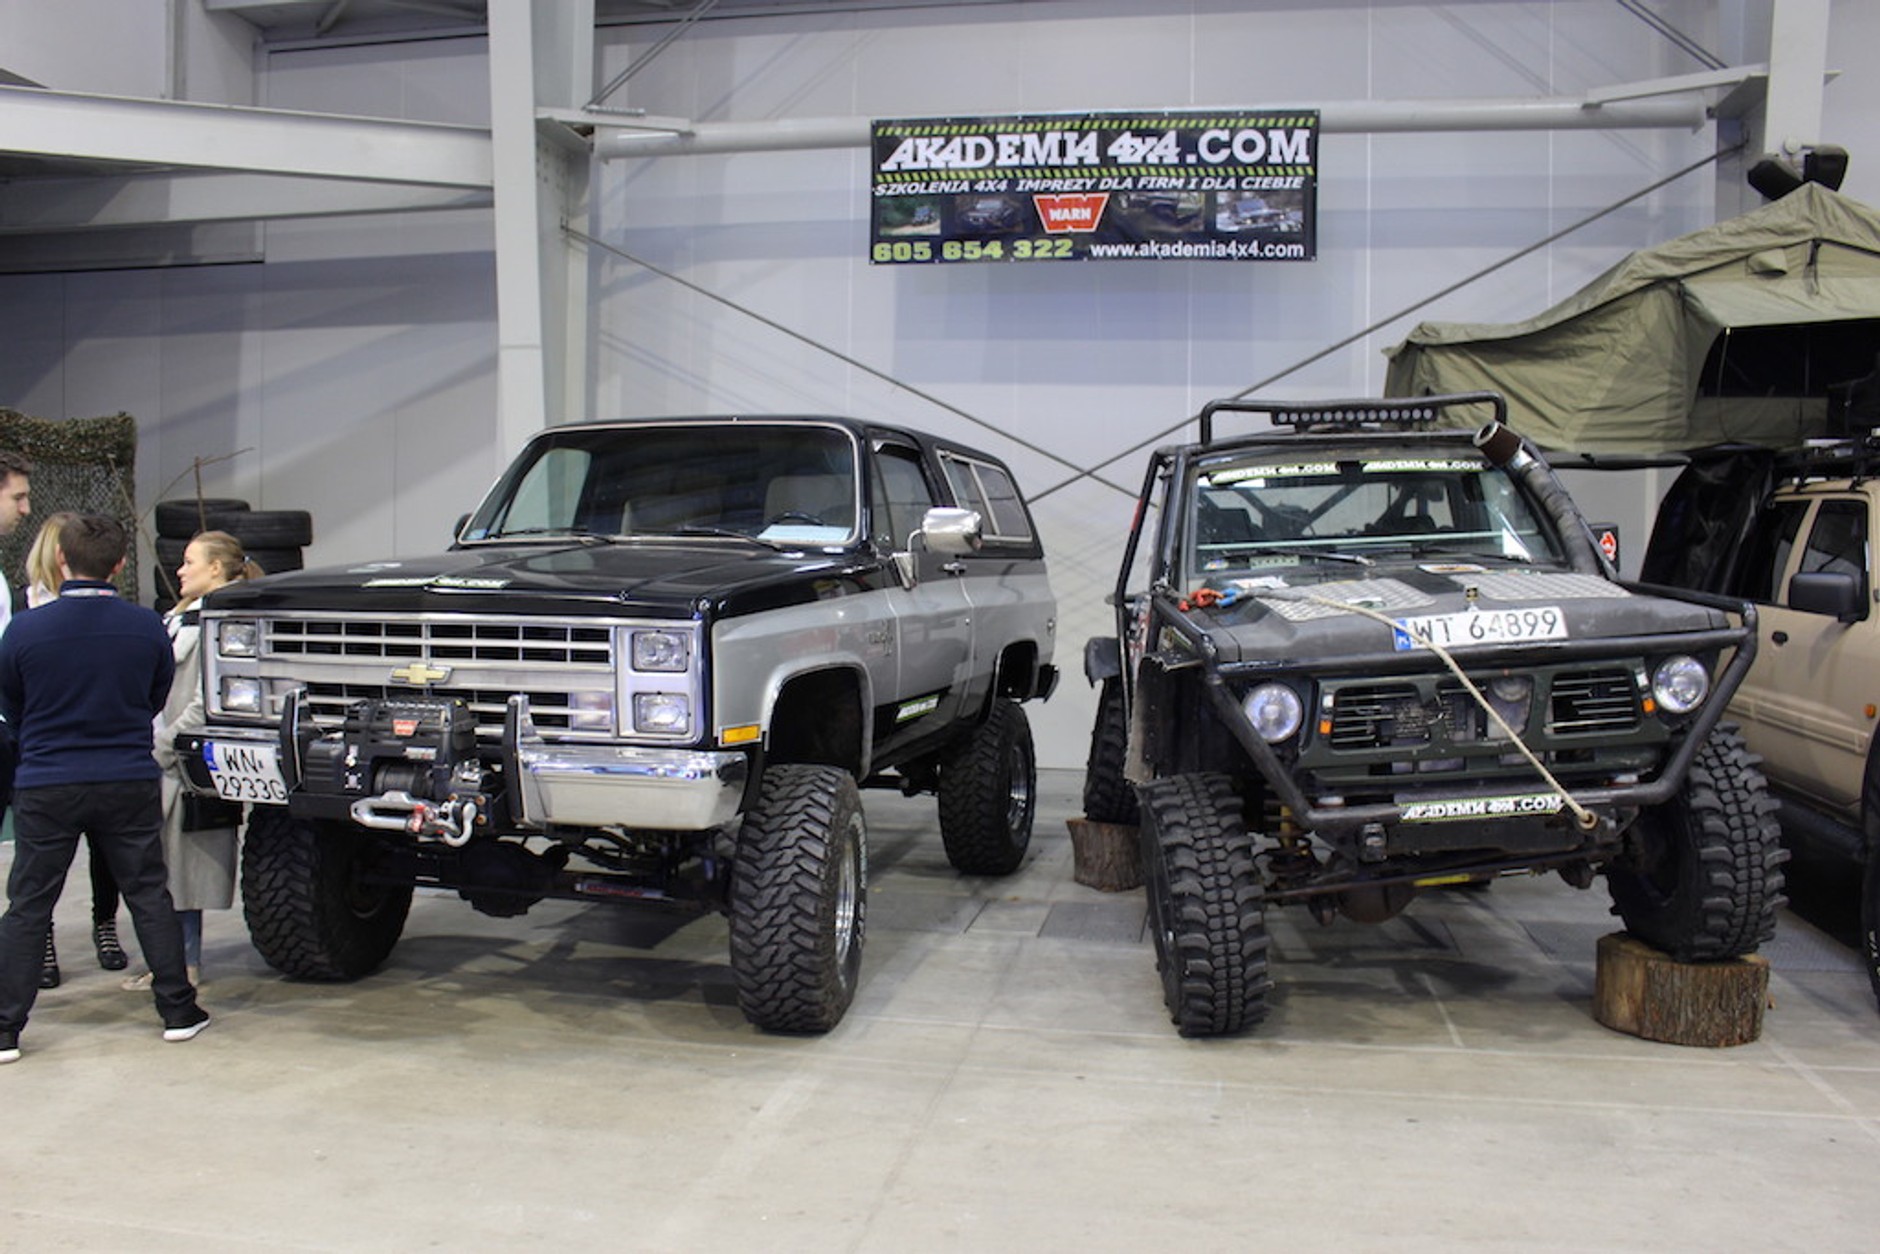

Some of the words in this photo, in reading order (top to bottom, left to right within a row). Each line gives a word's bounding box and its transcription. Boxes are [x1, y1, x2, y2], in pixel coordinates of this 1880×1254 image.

[880, 131, 1099, 171] AKADEMIA
[874, 181, 970, 196] SZKOLENIA
[974, 180, 1008, 192] 4X4
[1016, 178, 1097, 192] IMPREZY
[1100, 178, 1133, 190] DLA
[1137, 177, 1184, 189] FIRM
[1187, 177, 1199, 189] I
[1201, 177, 1238, 189] DLA
[1241, 176, 1305, 189] CIEBIE
[1049, 208, 1092, 221] WARN
[873, 242, 932, 262] 605
[942, 240, 1004, 260] 654
[1013, 238, 1074, 259] 322
[1089, 240, 1305, 257] www.akademia4x4.com
[1413, 618, 1453, 645] WT
[1469, 610, 1558, 640] 64899
[223, 747, 259, 773] WN
[216, 774, 287, 800] 2933G
